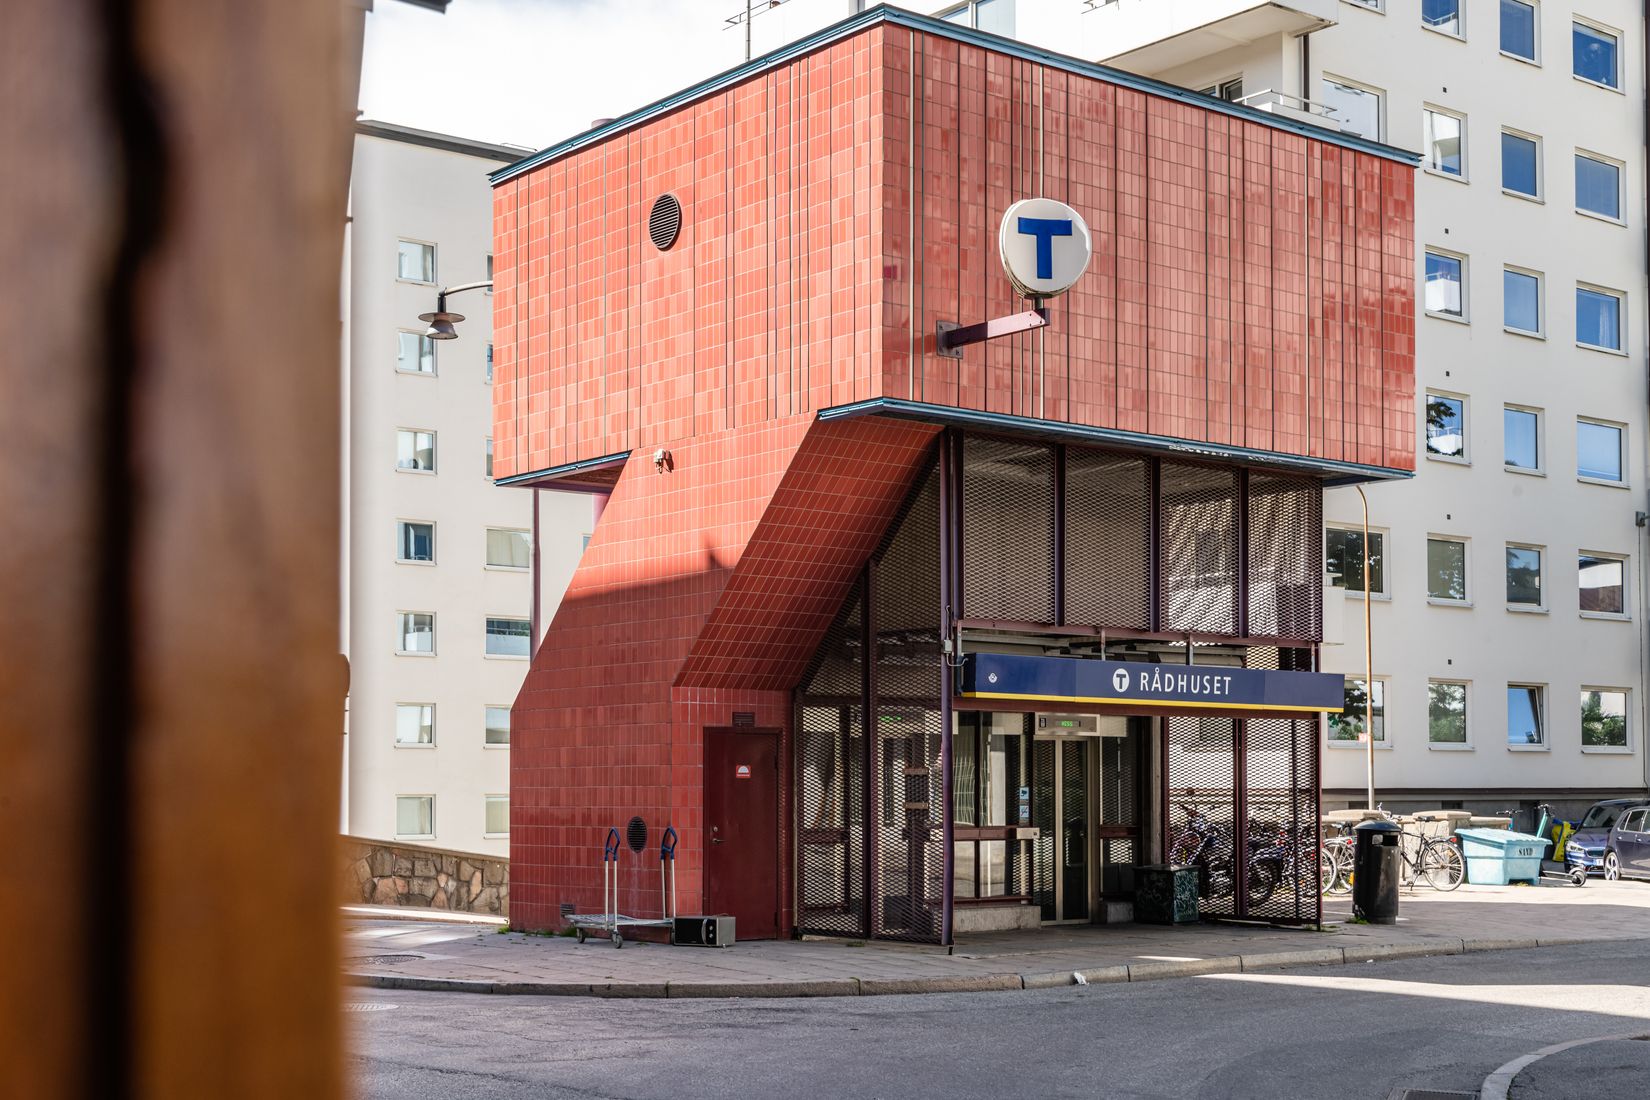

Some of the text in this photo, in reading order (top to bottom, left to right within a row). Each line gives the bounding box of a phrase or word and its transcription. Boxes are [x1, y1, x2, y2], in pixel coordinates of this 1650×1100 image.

[1017, 216, 1072, 279] T
[1140, 667, 1231, 695] RÅDHUSET
[1518, 847, 1533, 856] SAND
